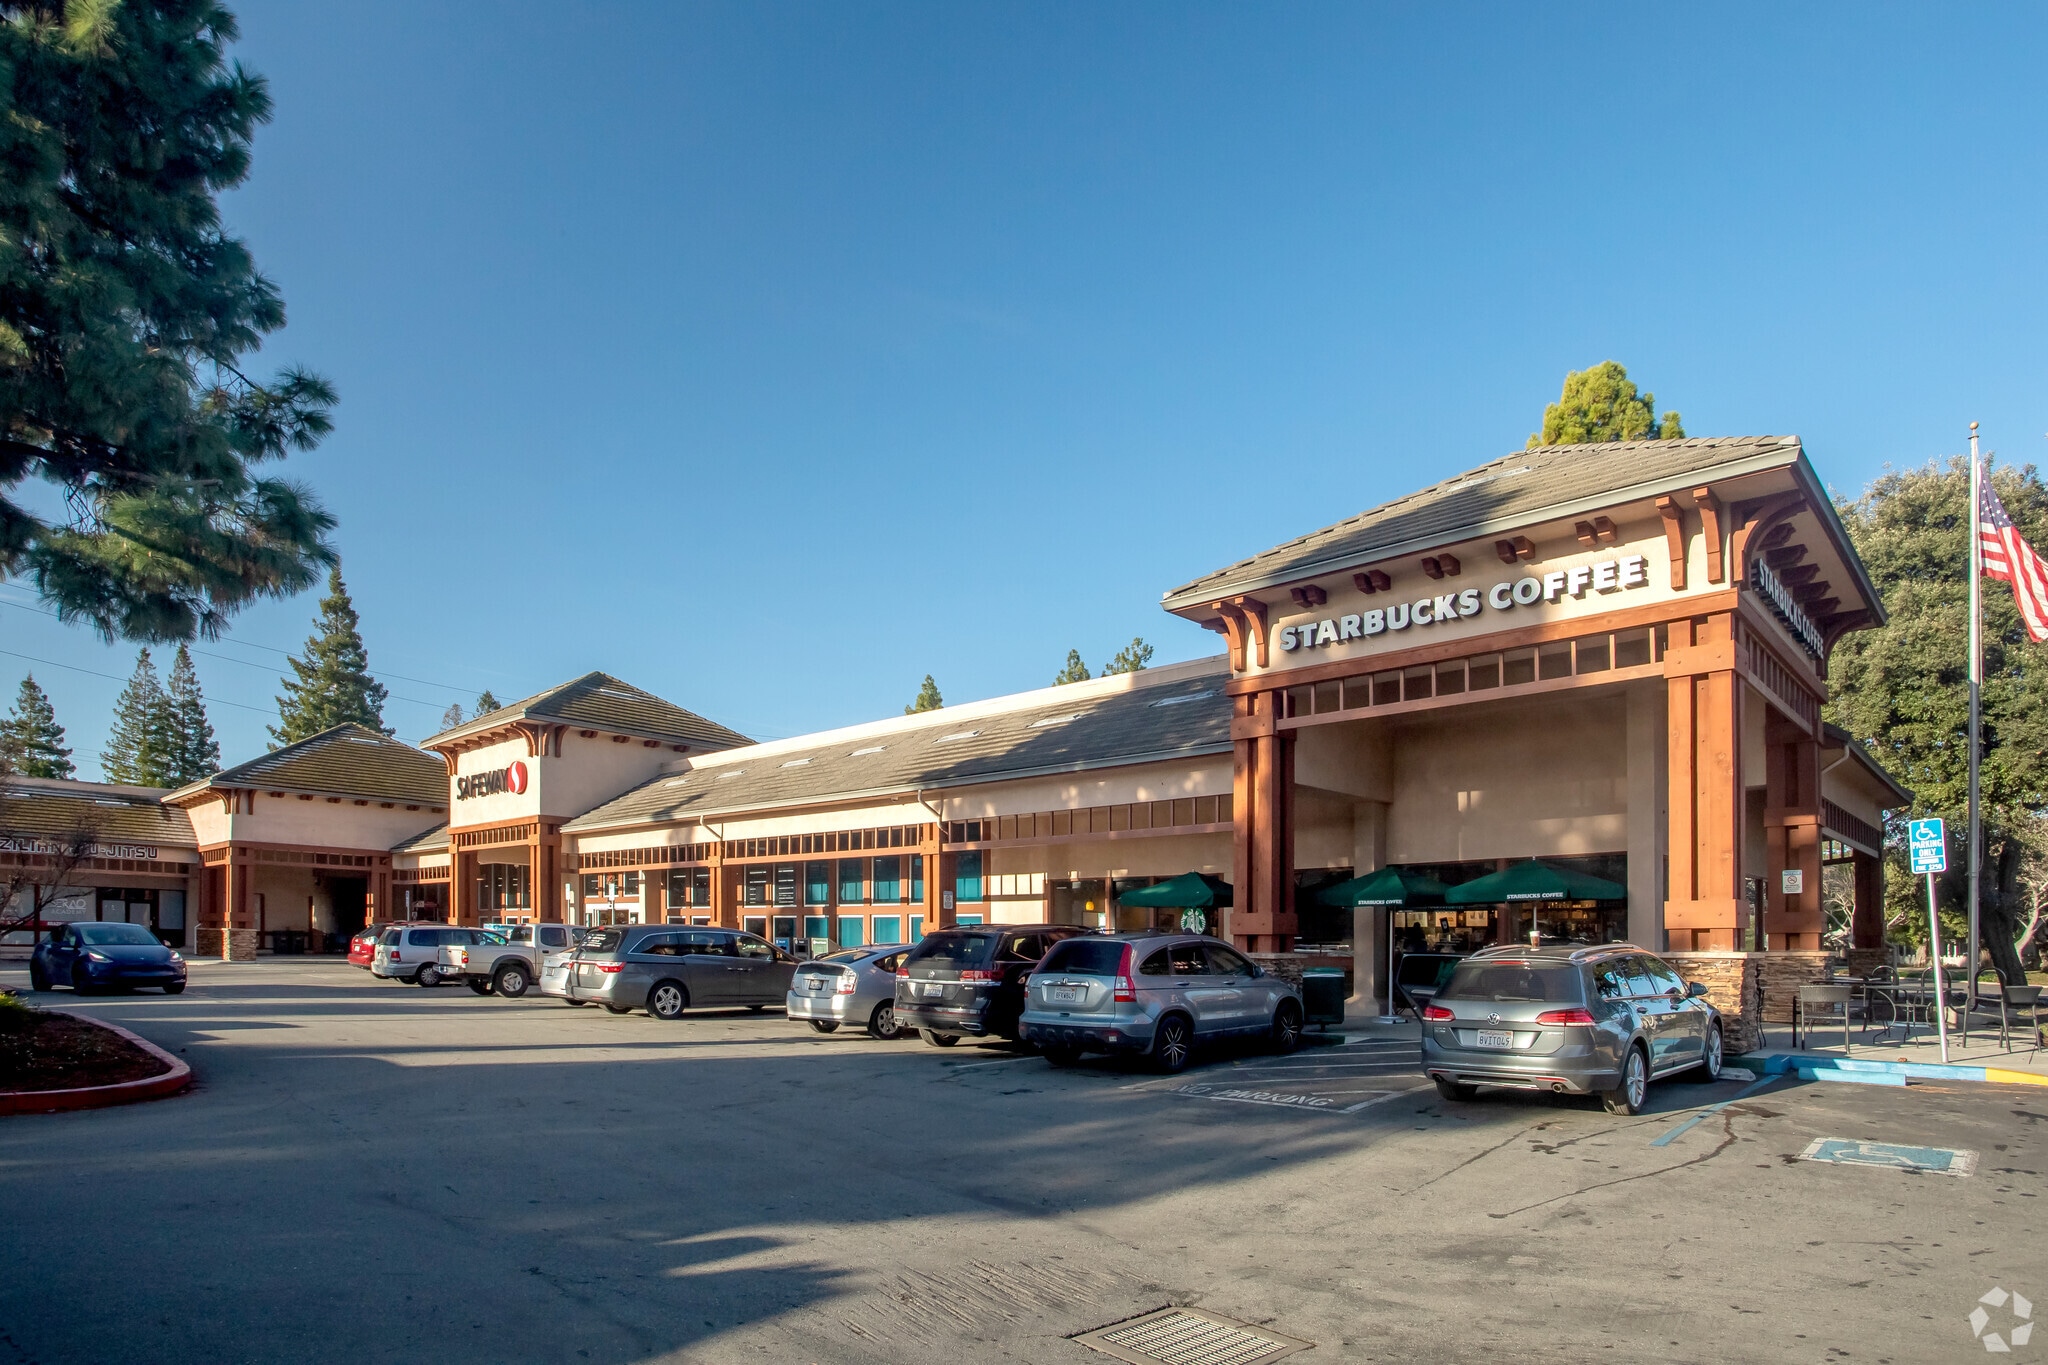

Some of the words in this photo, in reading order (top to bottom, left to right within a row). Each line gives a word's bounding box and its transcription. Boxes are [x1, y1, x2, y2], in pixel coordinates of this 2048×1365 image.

[1280, 588, 1482, 651] STARBUCKS
[1488, 554, 1649, 611] COFFEE
[1758, 558, 1802, 632] STARBUCKS
[1802, 618, 1824, 659] COFFEE
[457, 768, 510, 801] SAFEWAY
[1912, 839, 1942, 849] PARKING
[1918, 848, 1937, 857] ONLY
[1212, 1089, 1334, 1106] PARKING
